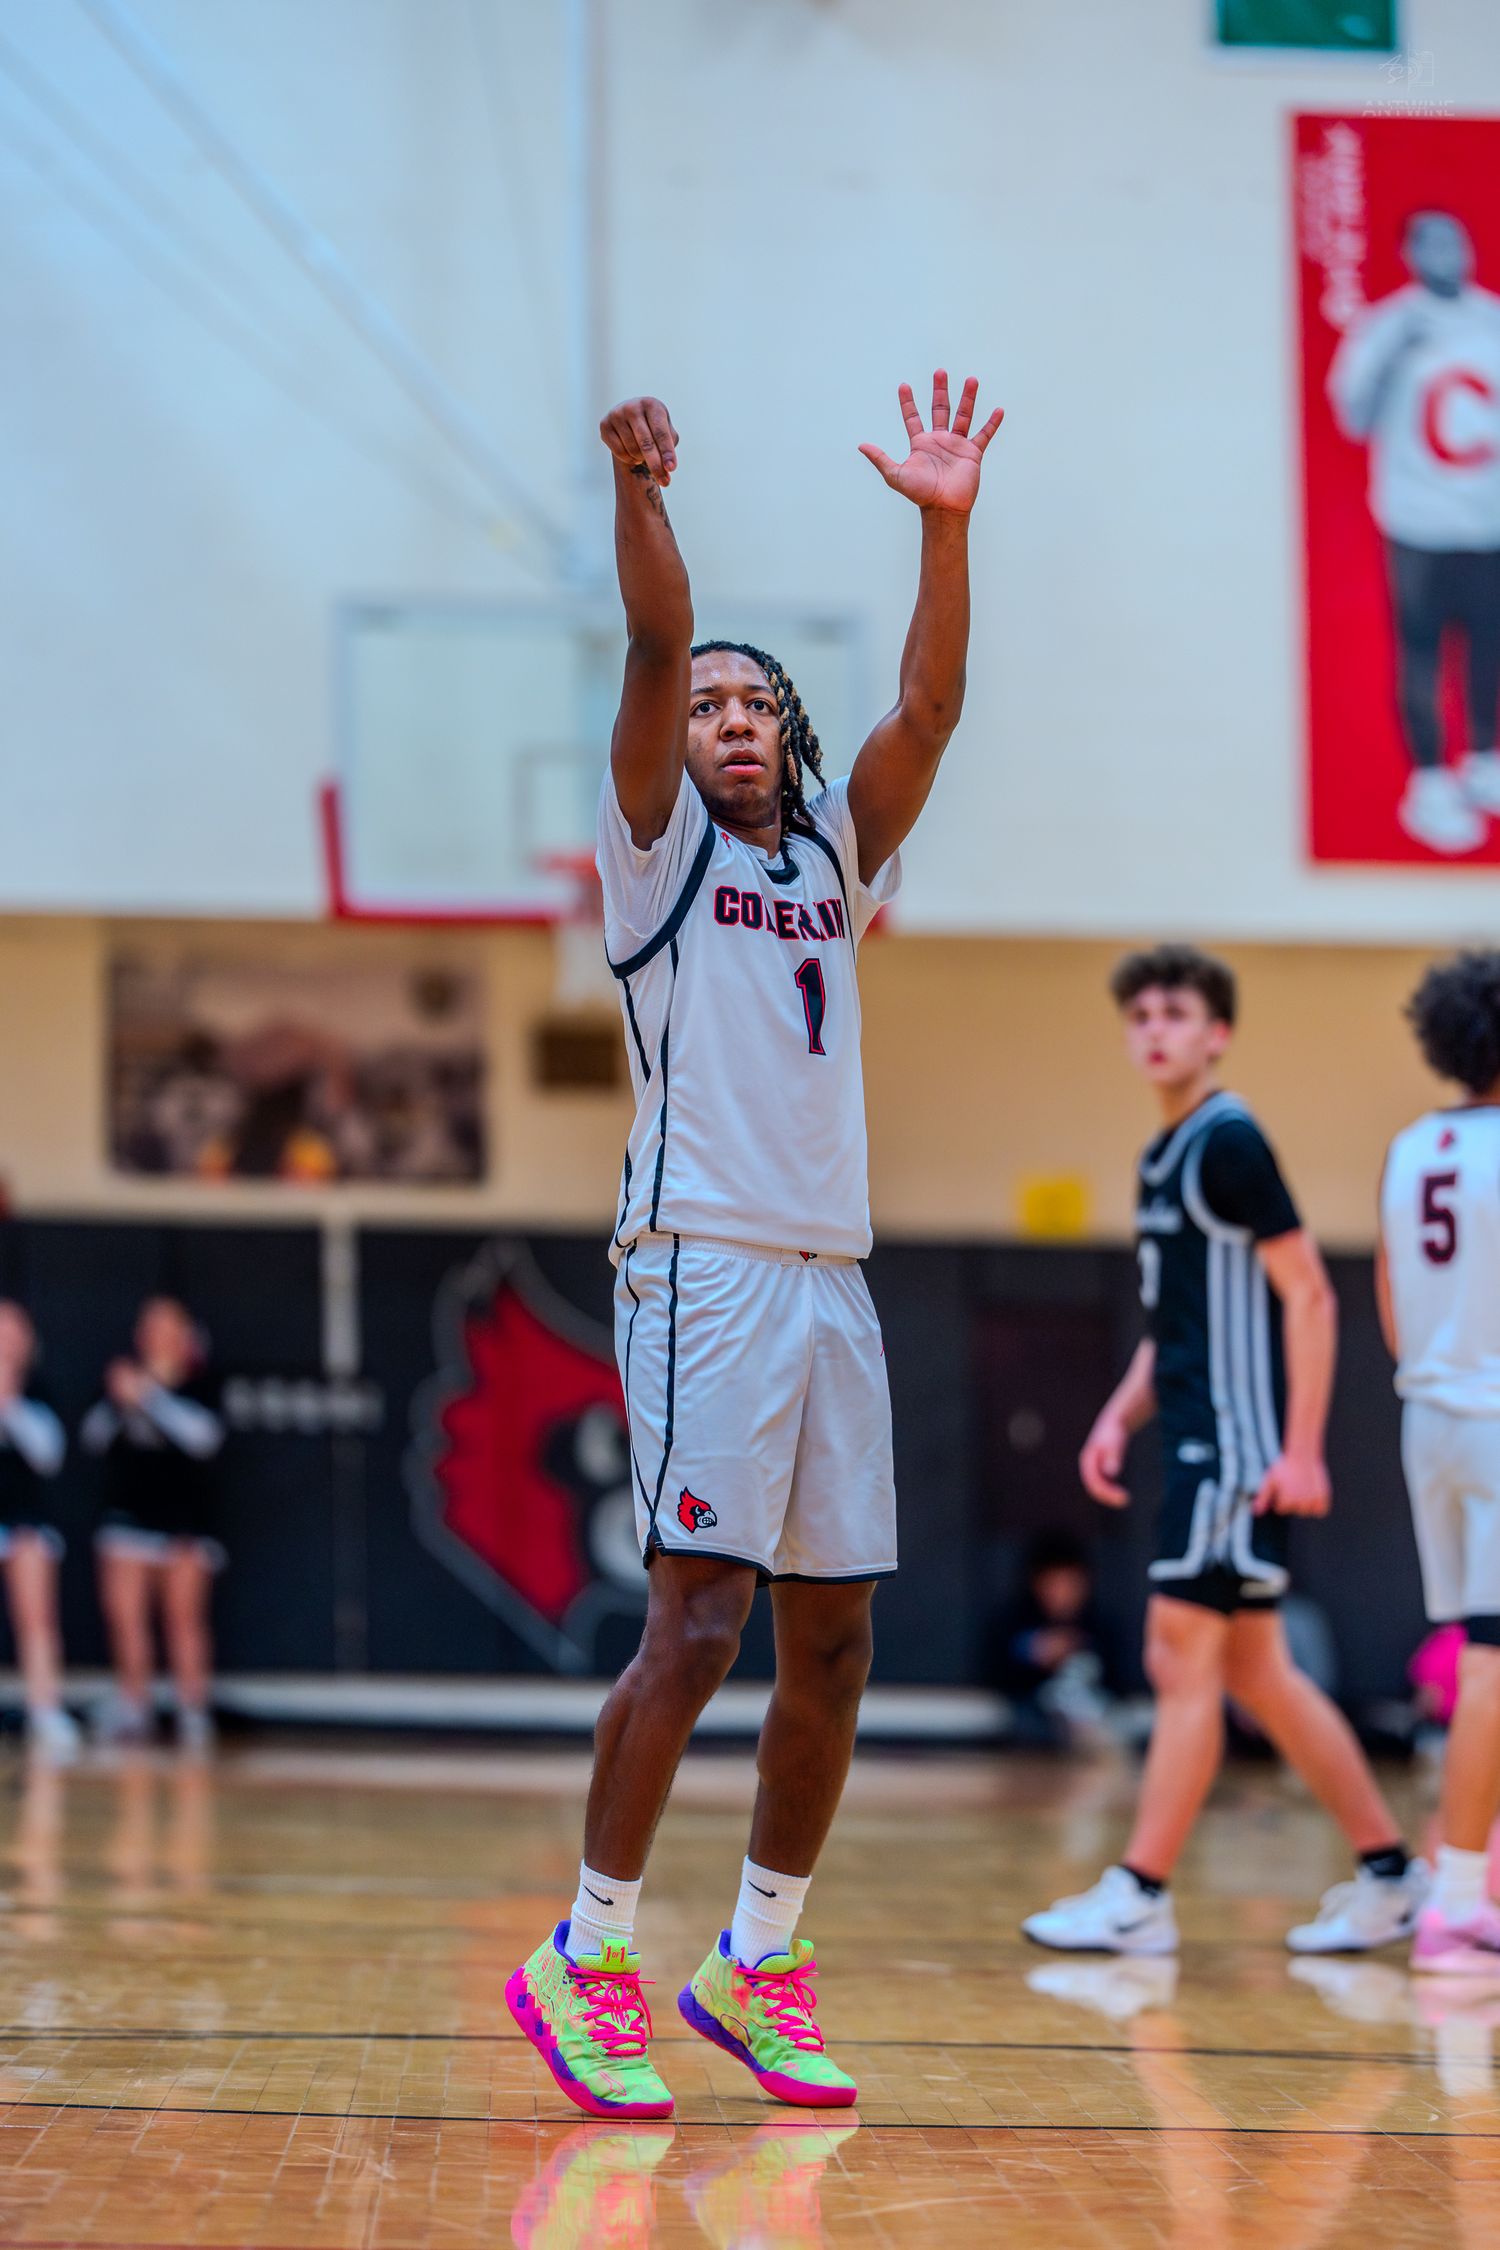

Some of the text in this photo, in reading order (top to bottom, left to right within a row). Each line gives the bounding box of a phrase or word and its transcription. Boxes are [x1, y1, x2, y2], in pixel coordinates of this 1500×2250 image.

[1416, 365, 1498, 472] C
[714, 885, 846, 942] COLERIN
[794, 958, 826, 1056] 1
[1421, 1172, 1457, 1264] 5
[605, 1945, 612, 1964] 1
[619, 1946, 626, 1965] 1
